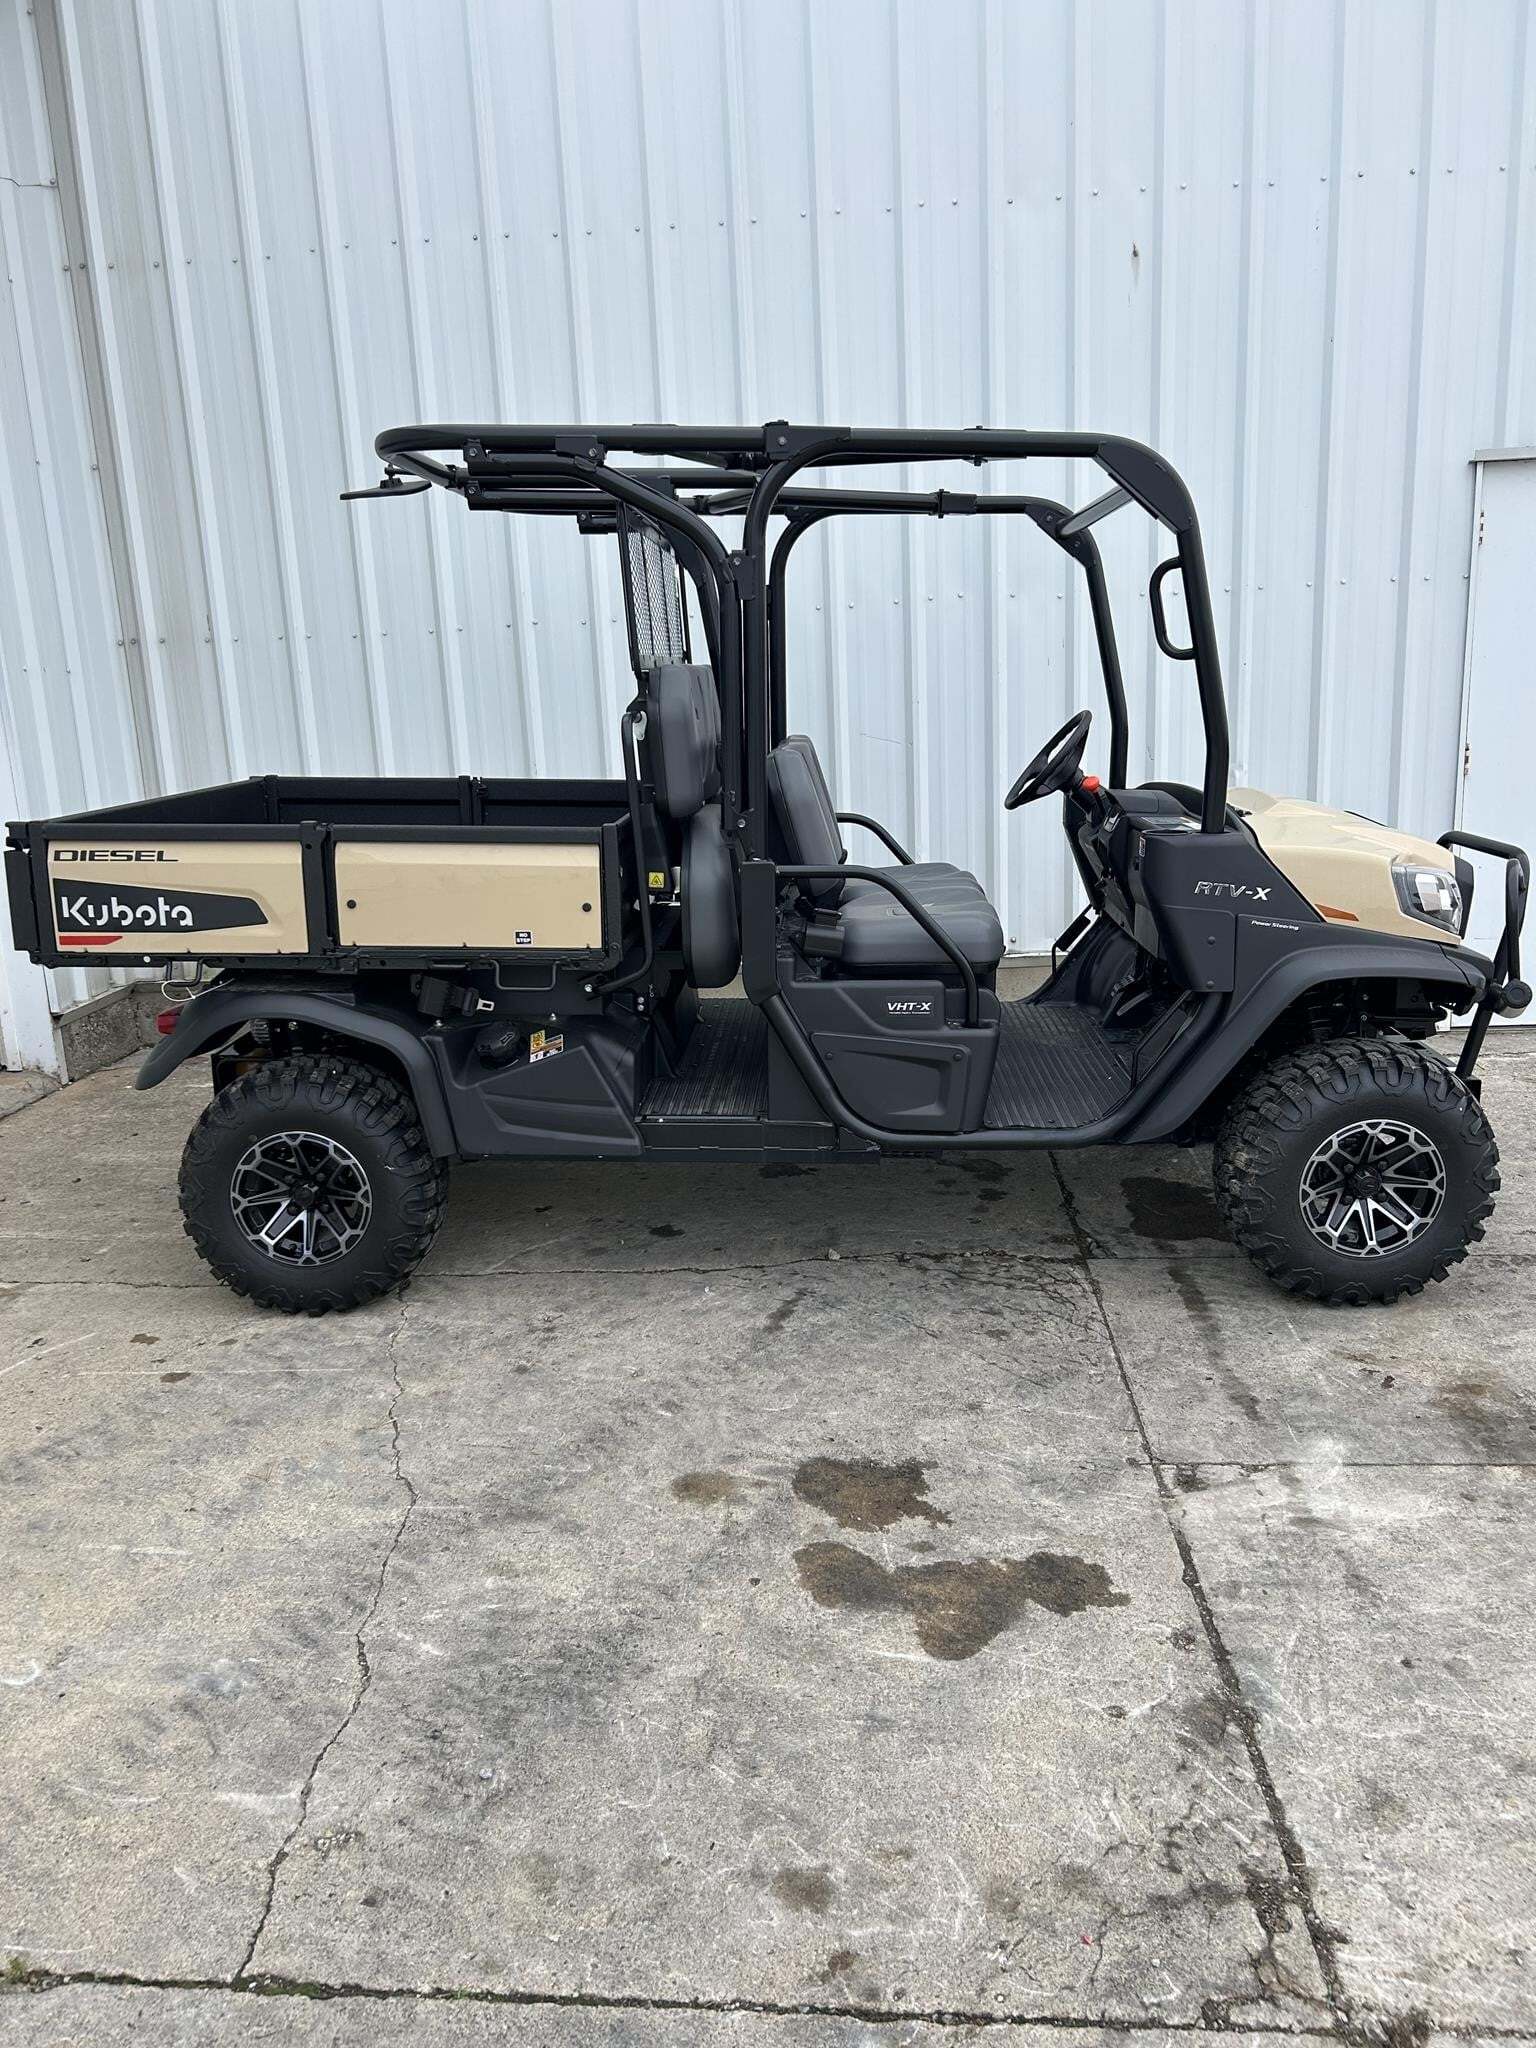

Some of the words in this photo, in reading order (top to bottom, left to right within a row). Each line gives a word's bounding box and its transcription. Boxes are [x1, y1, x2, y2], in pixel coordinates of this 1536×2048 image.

[53, 850, 179, 862] DIESEL
[1194, 881, 1272, 901] RTV-X
[61, 896, 194, 926] Kubota
[1272, 922, 1299, 931] Steering
[888, 1002, 932, 1011] VHT-X
